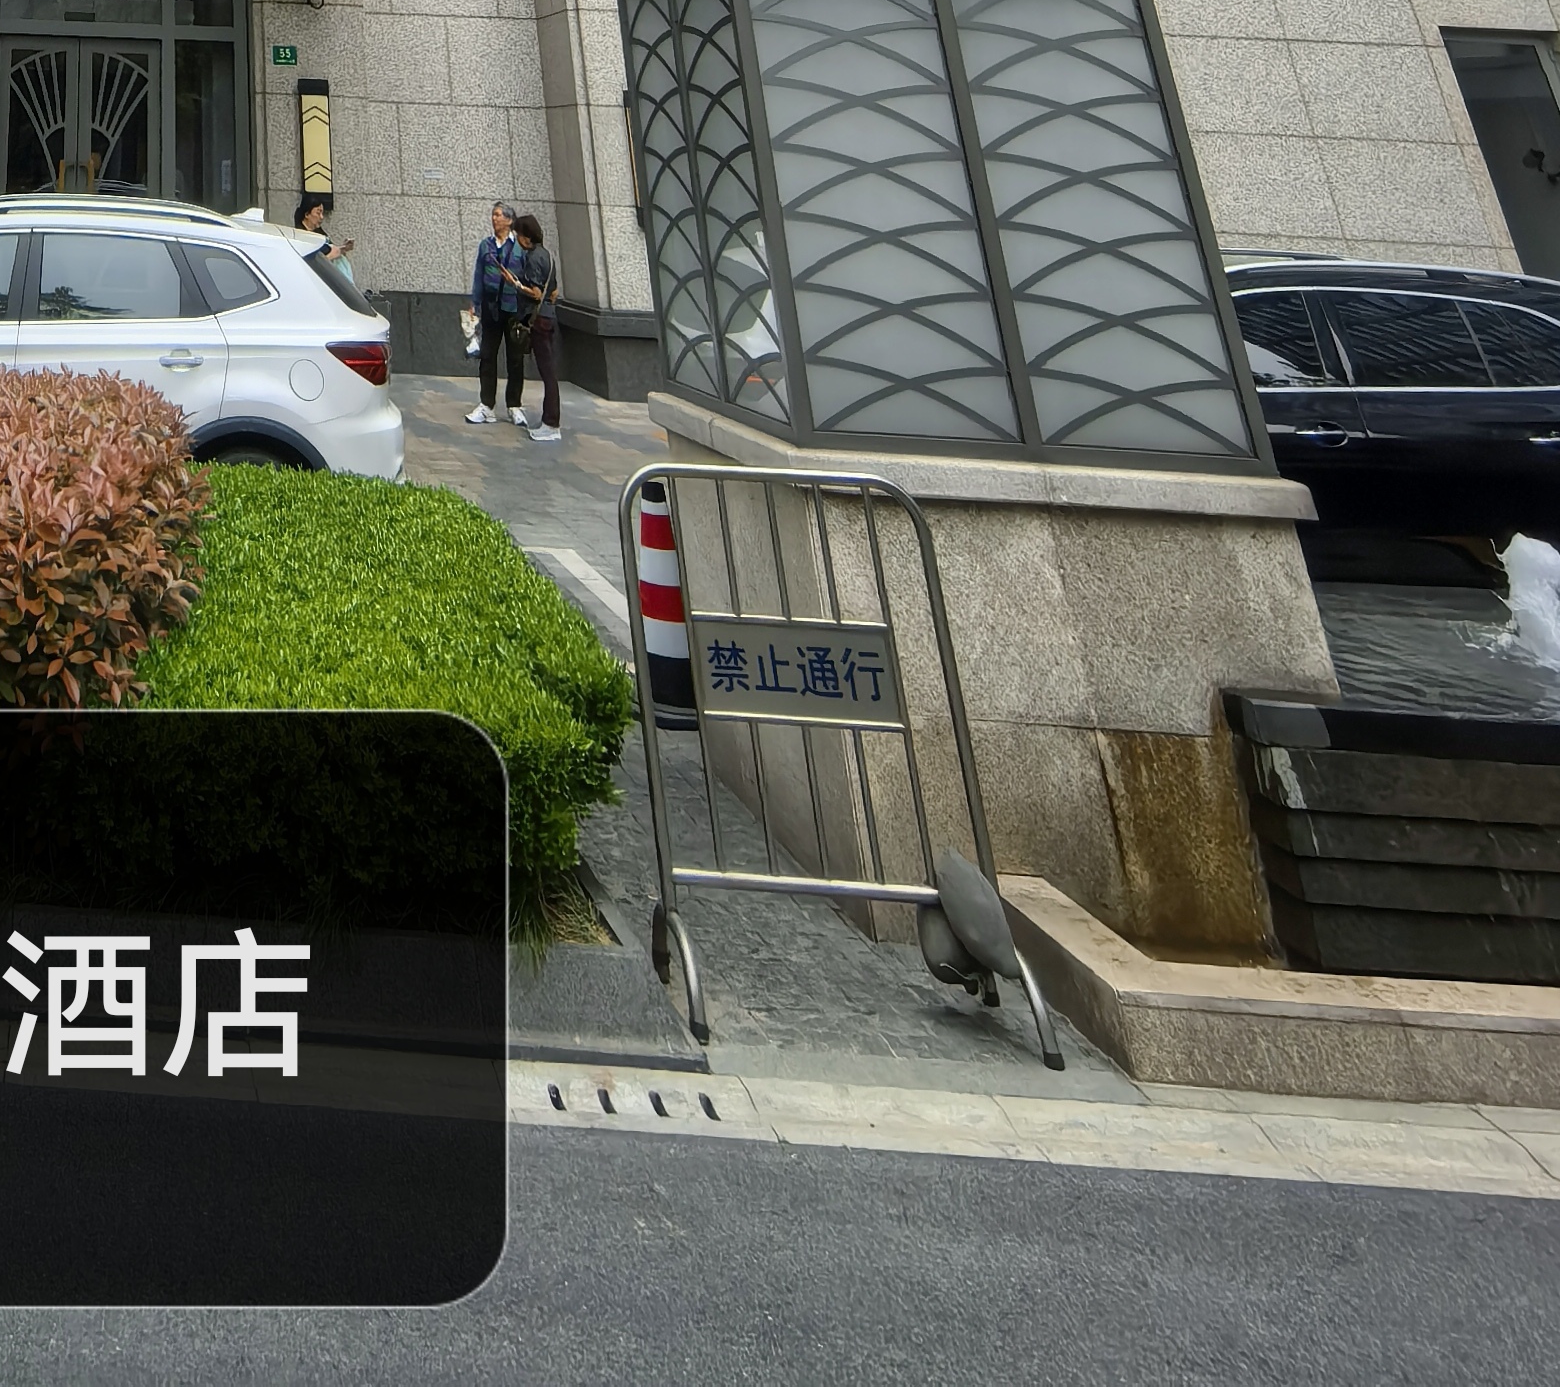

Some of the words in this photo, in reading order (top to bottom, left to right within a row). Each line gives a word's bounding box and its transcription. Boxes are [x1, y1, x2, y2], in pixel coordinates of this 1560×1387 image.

[279, 48, 291, 58] 55
[707, 639, 884, 701] 禁止通行
